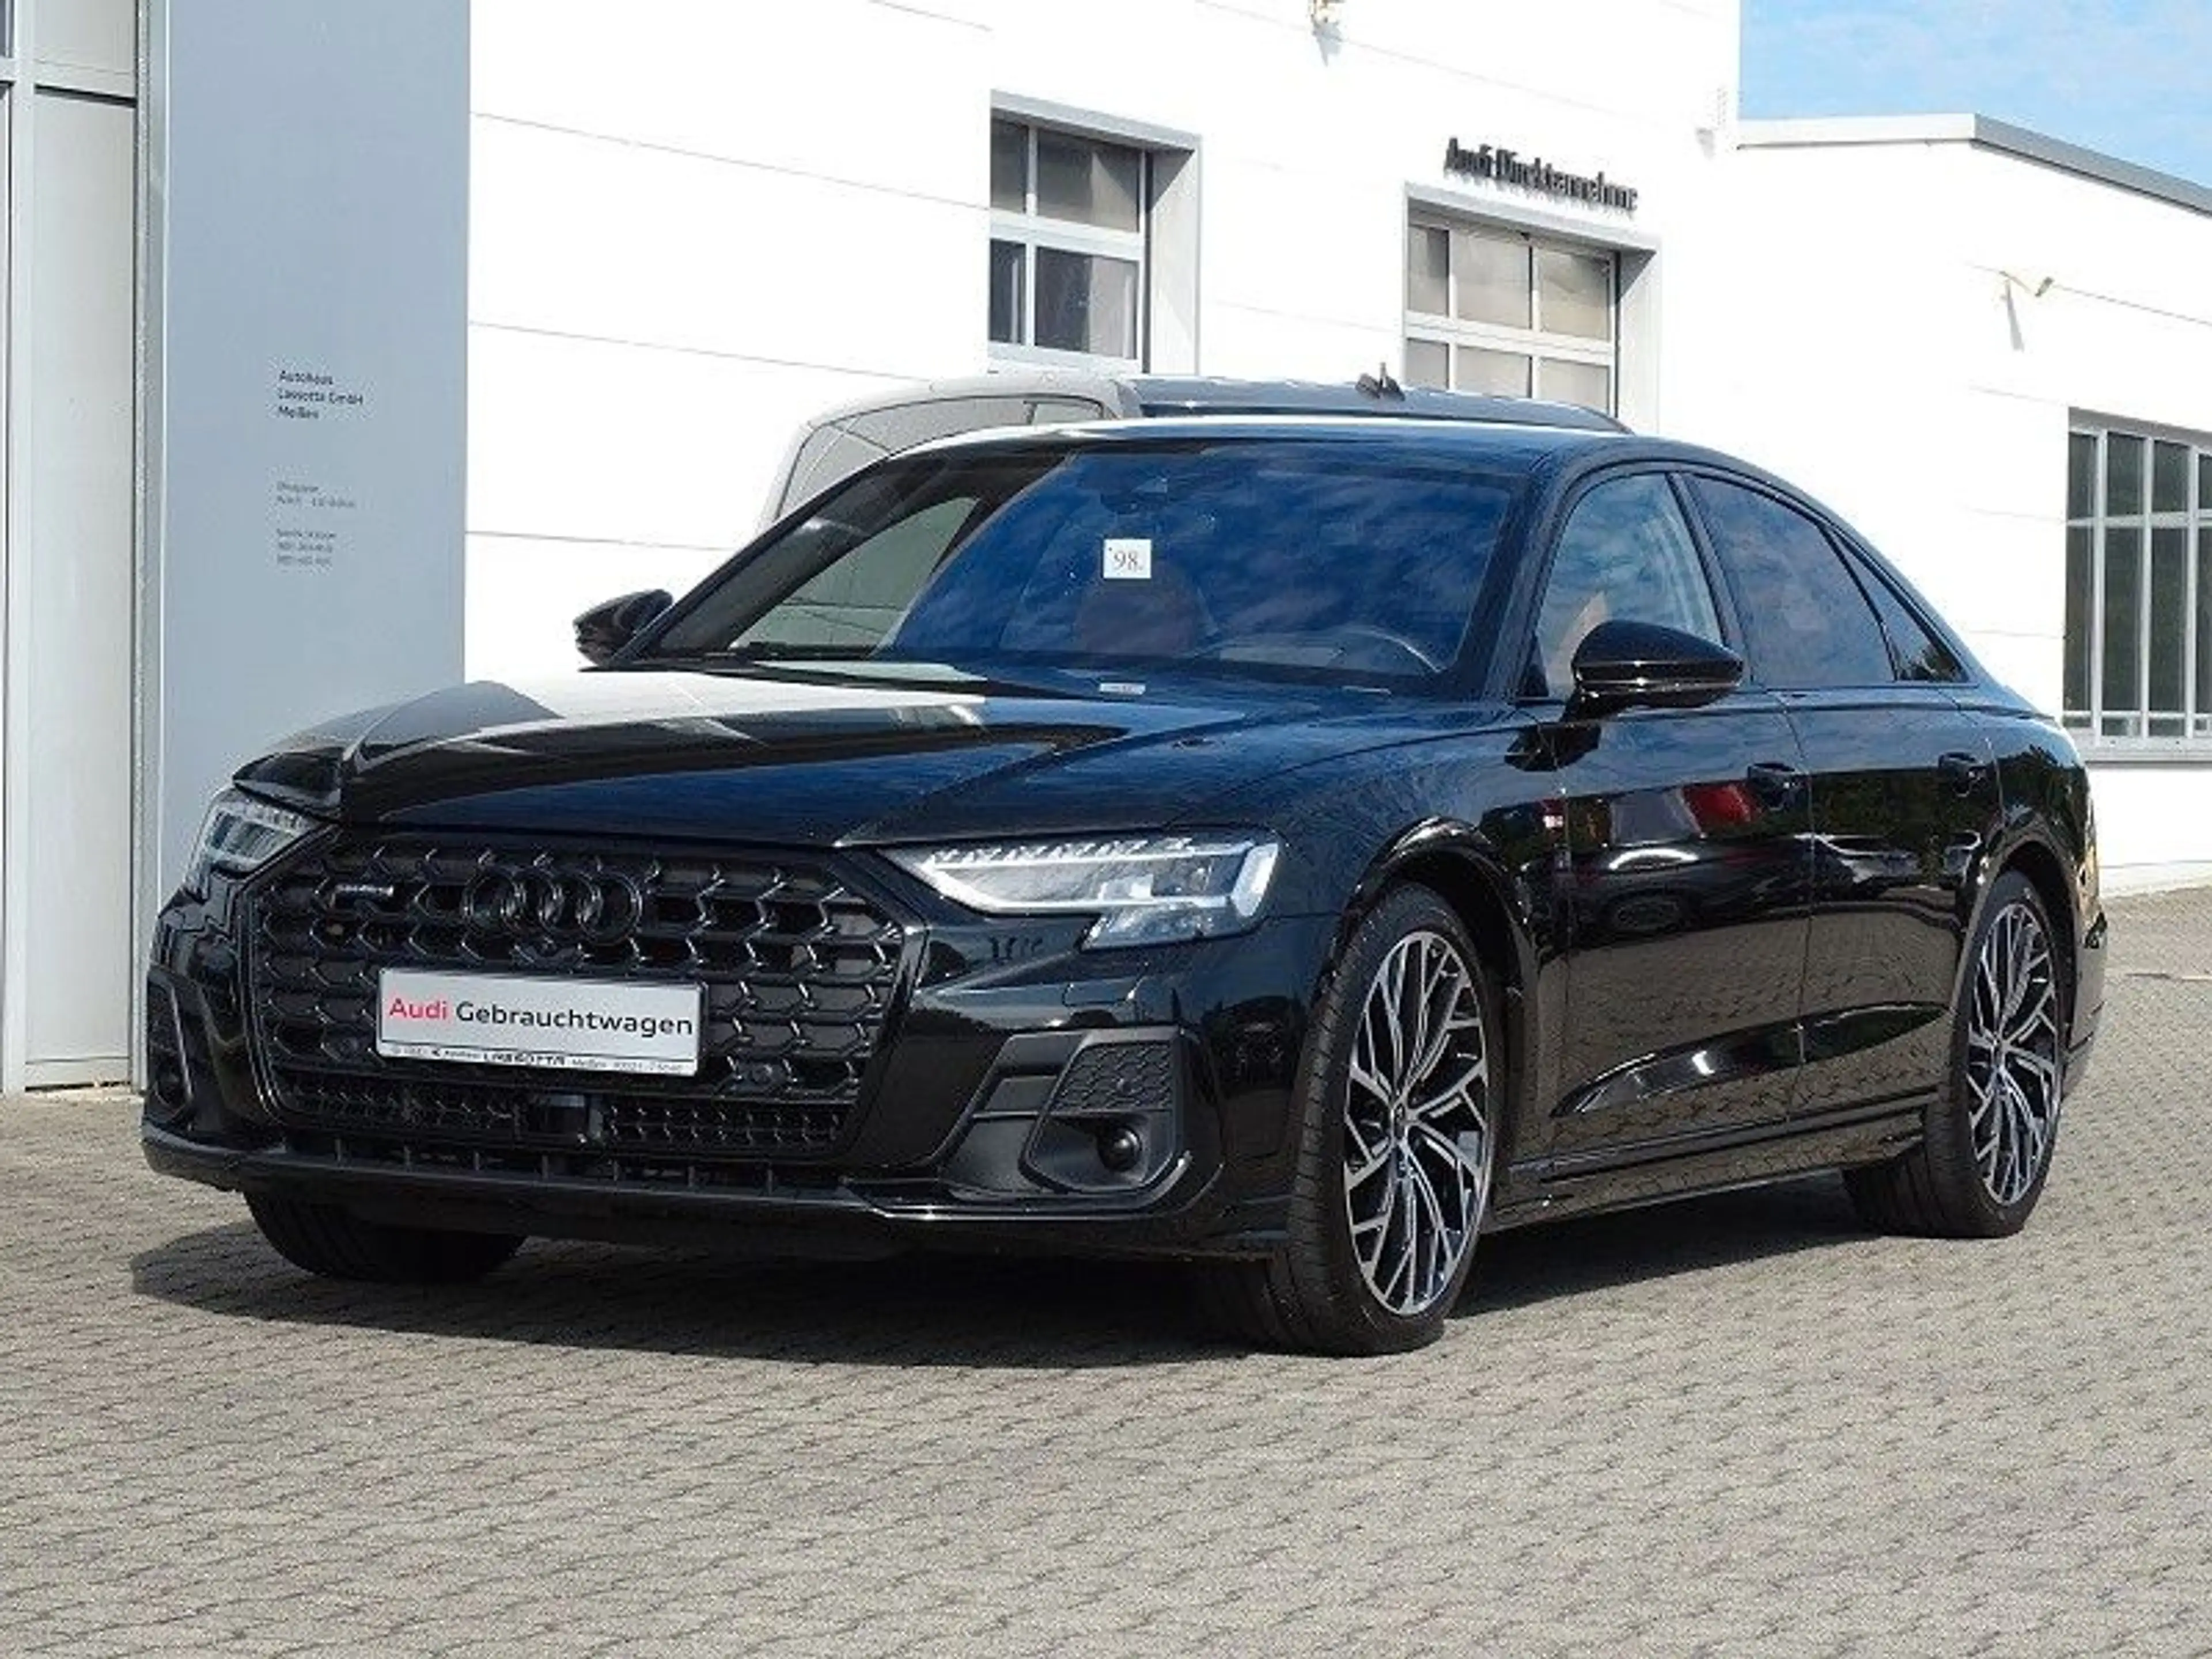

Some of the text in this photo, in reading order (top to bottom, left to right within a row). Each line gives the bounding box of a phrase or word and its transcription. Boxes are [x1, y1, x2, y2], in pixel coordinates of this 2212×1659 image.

[1444, 138, 1493, 177] Audi
[389, 998, 692, 1038] Audi Gebrauchtwagen
